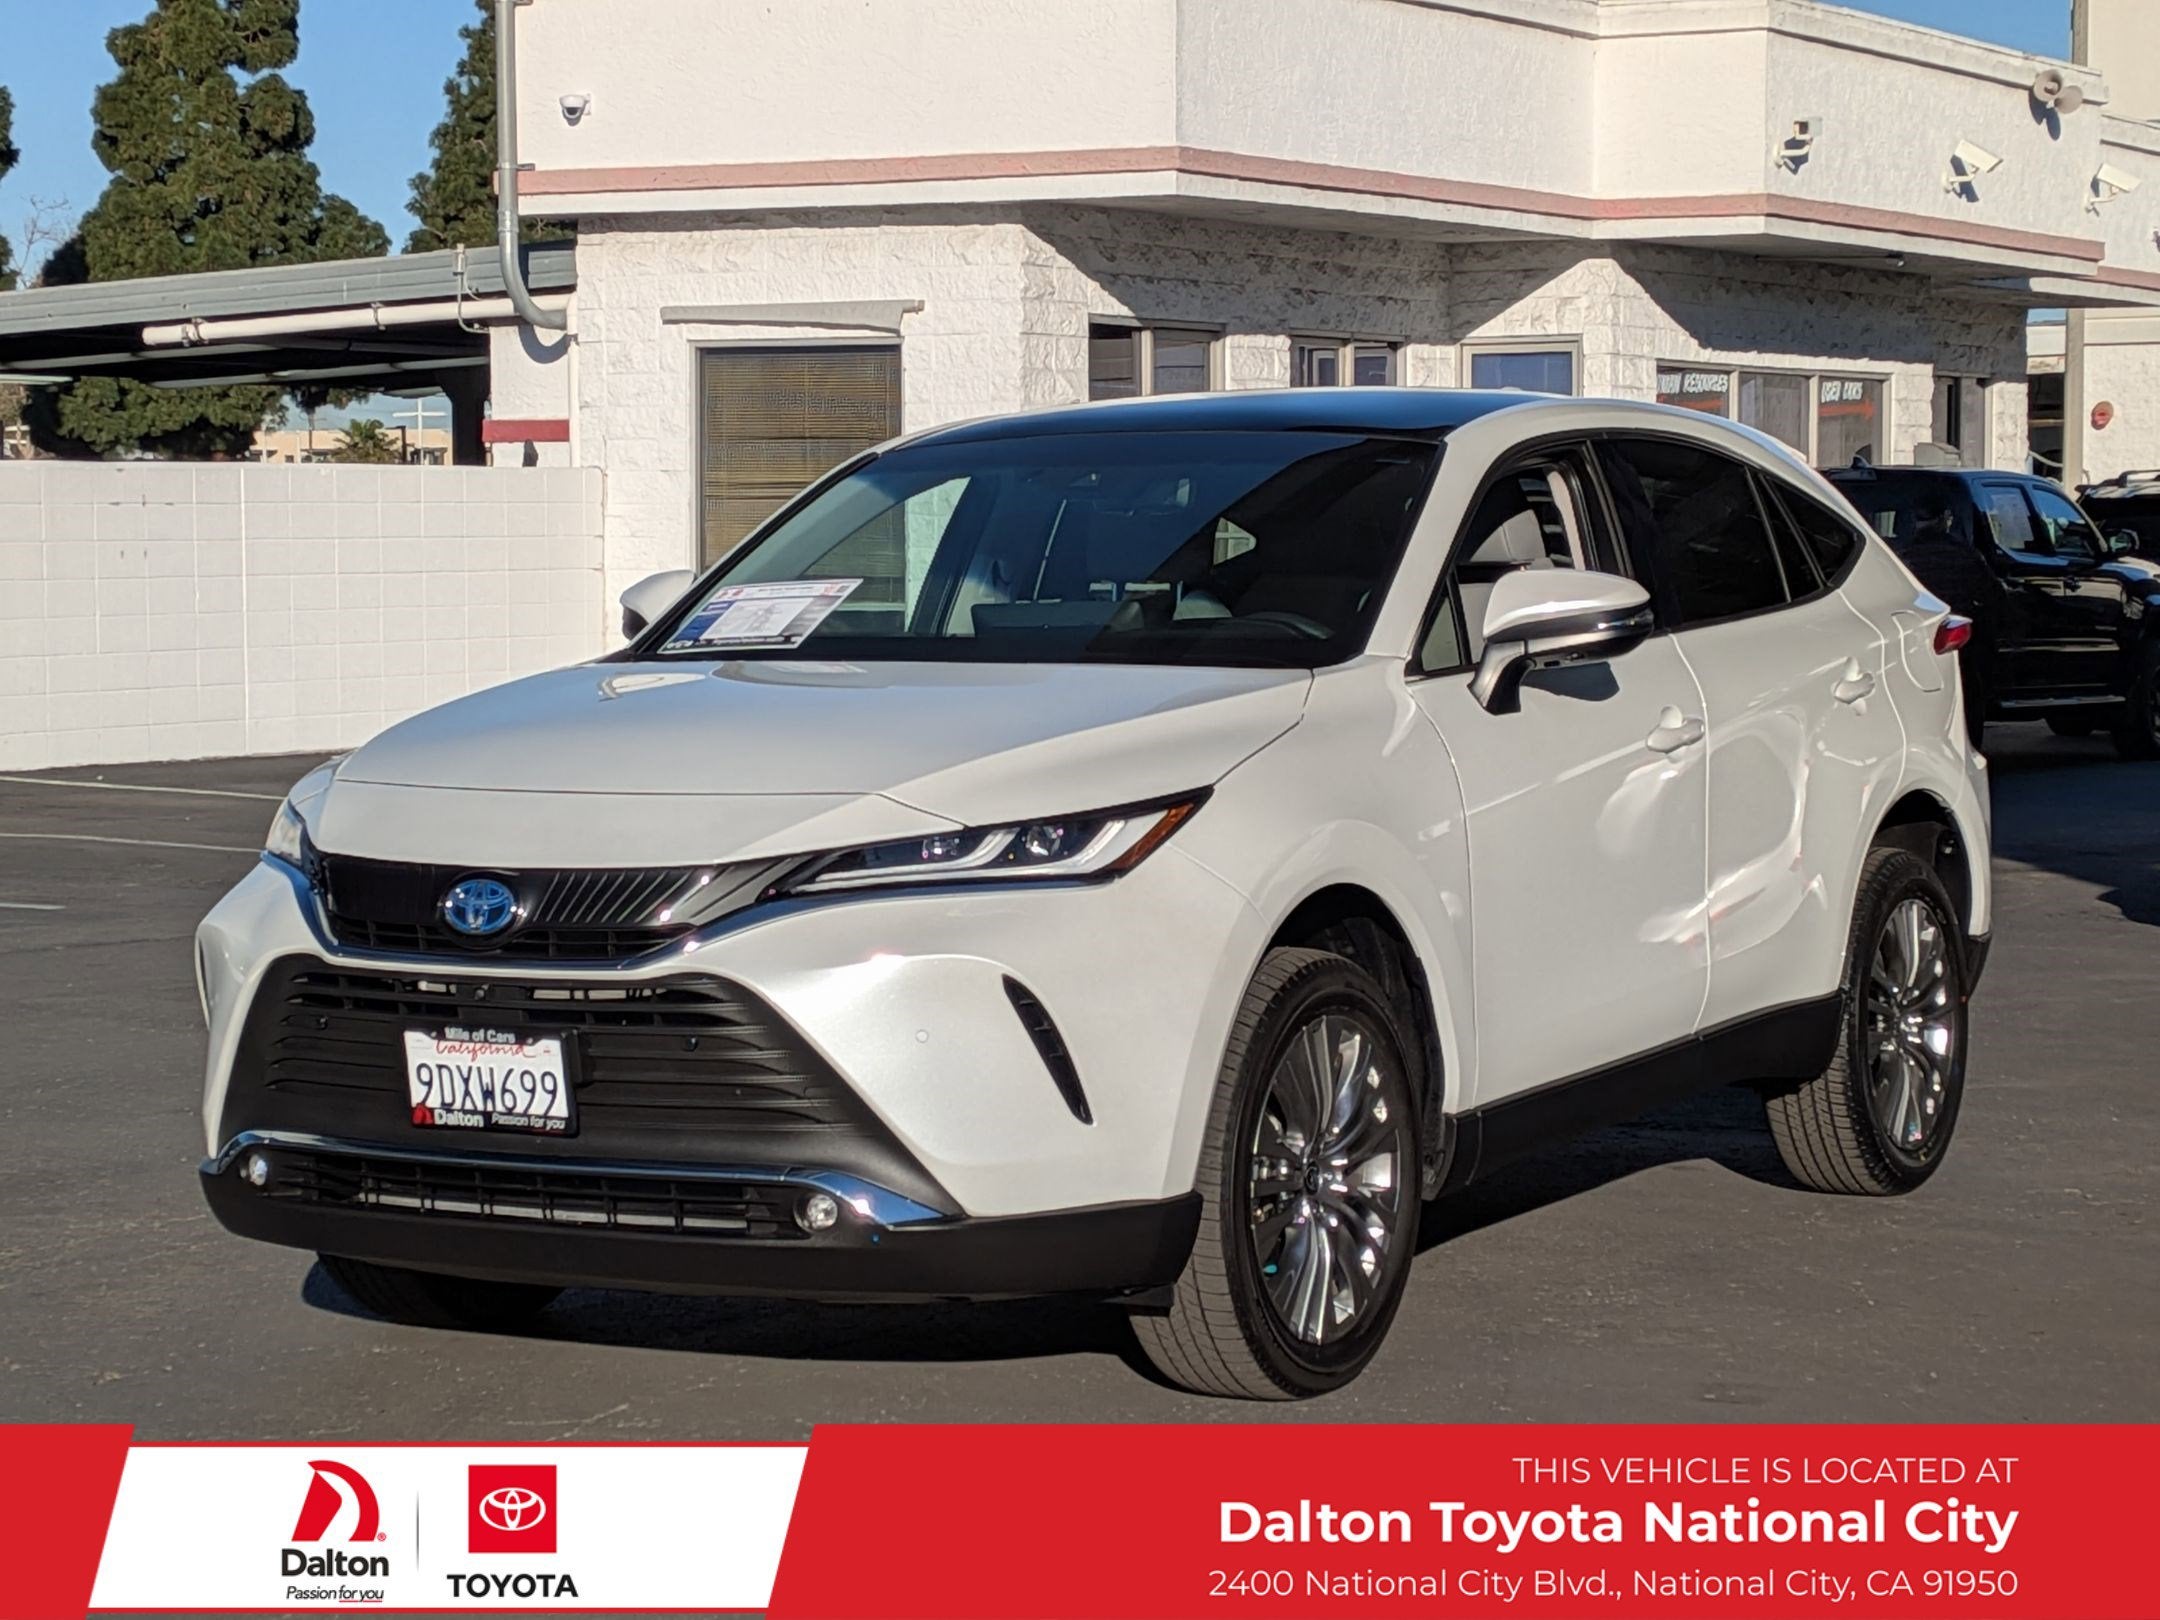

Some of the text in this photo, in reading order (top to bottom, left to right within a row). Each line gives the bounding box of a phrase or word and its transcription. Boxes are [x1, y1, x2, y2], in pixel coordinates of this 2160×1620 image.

[444, 1026, 516, 1044] Mile of Cars
[435, 1039, 537, 1062] California
[415, 1062, 558, 1117] 9DXW699
[434, 1109, 567, 1131] Dalton Passion for you
